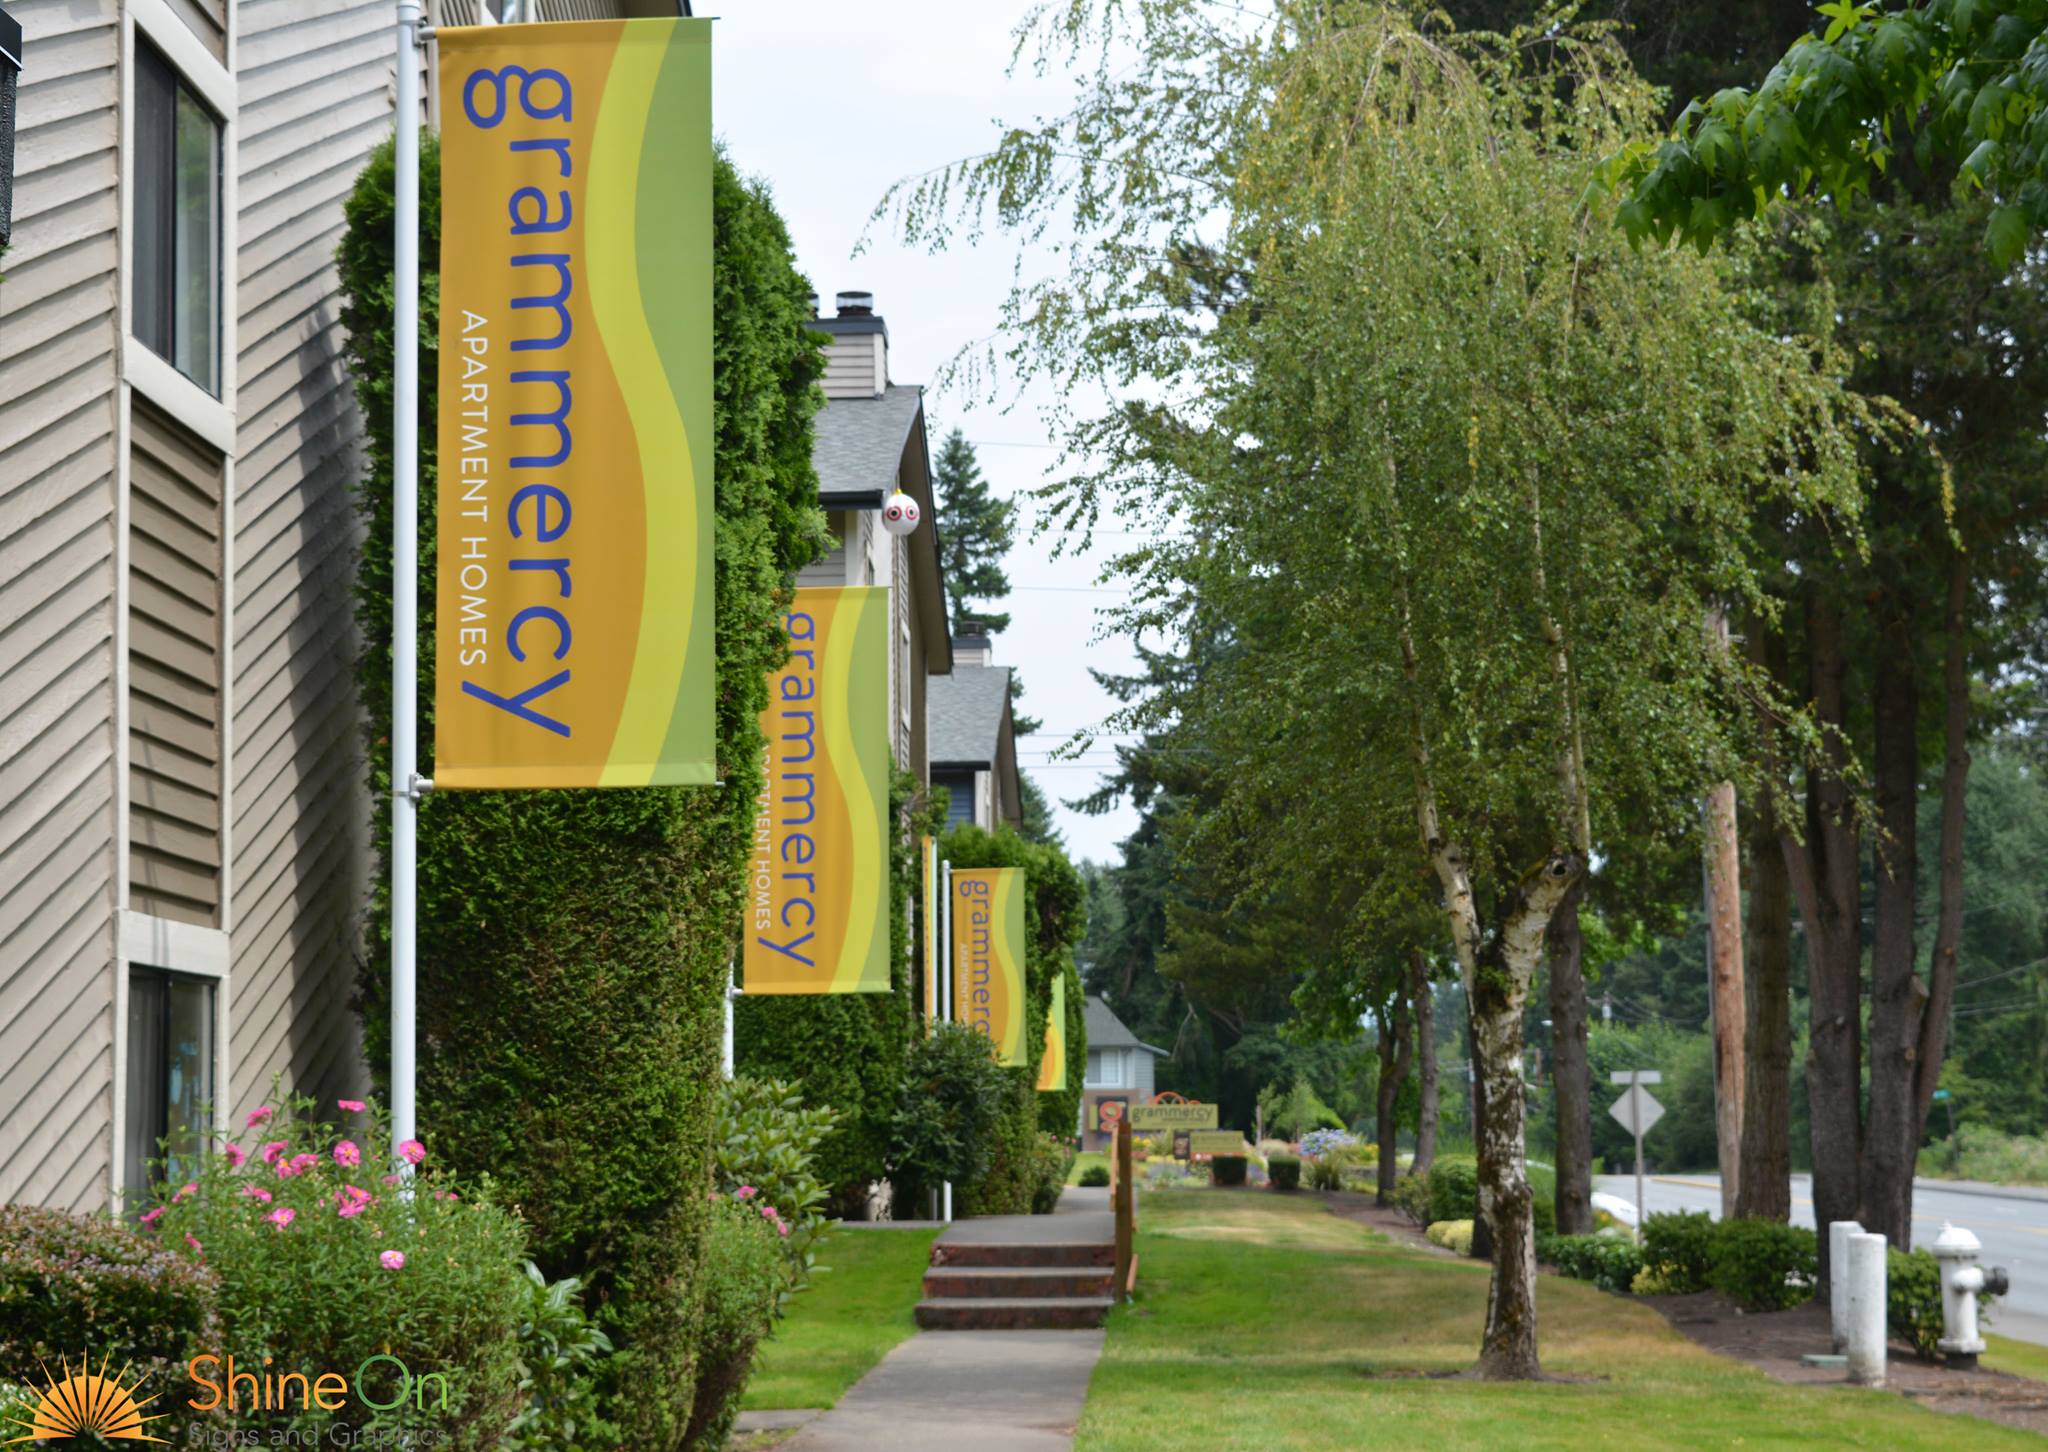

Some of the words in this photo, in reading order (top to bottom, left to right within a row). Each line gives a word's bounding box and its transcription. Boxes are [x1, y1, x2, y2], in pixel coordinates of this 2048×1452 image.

[461, 309, 489, 522] APARTMENT
[463, 64, 573, 738] grammercy
[459, 536, 488, 666] HOMES
[755, 859, 771, 931] HOMES
[959, 879, 990, 1041] grammerc
